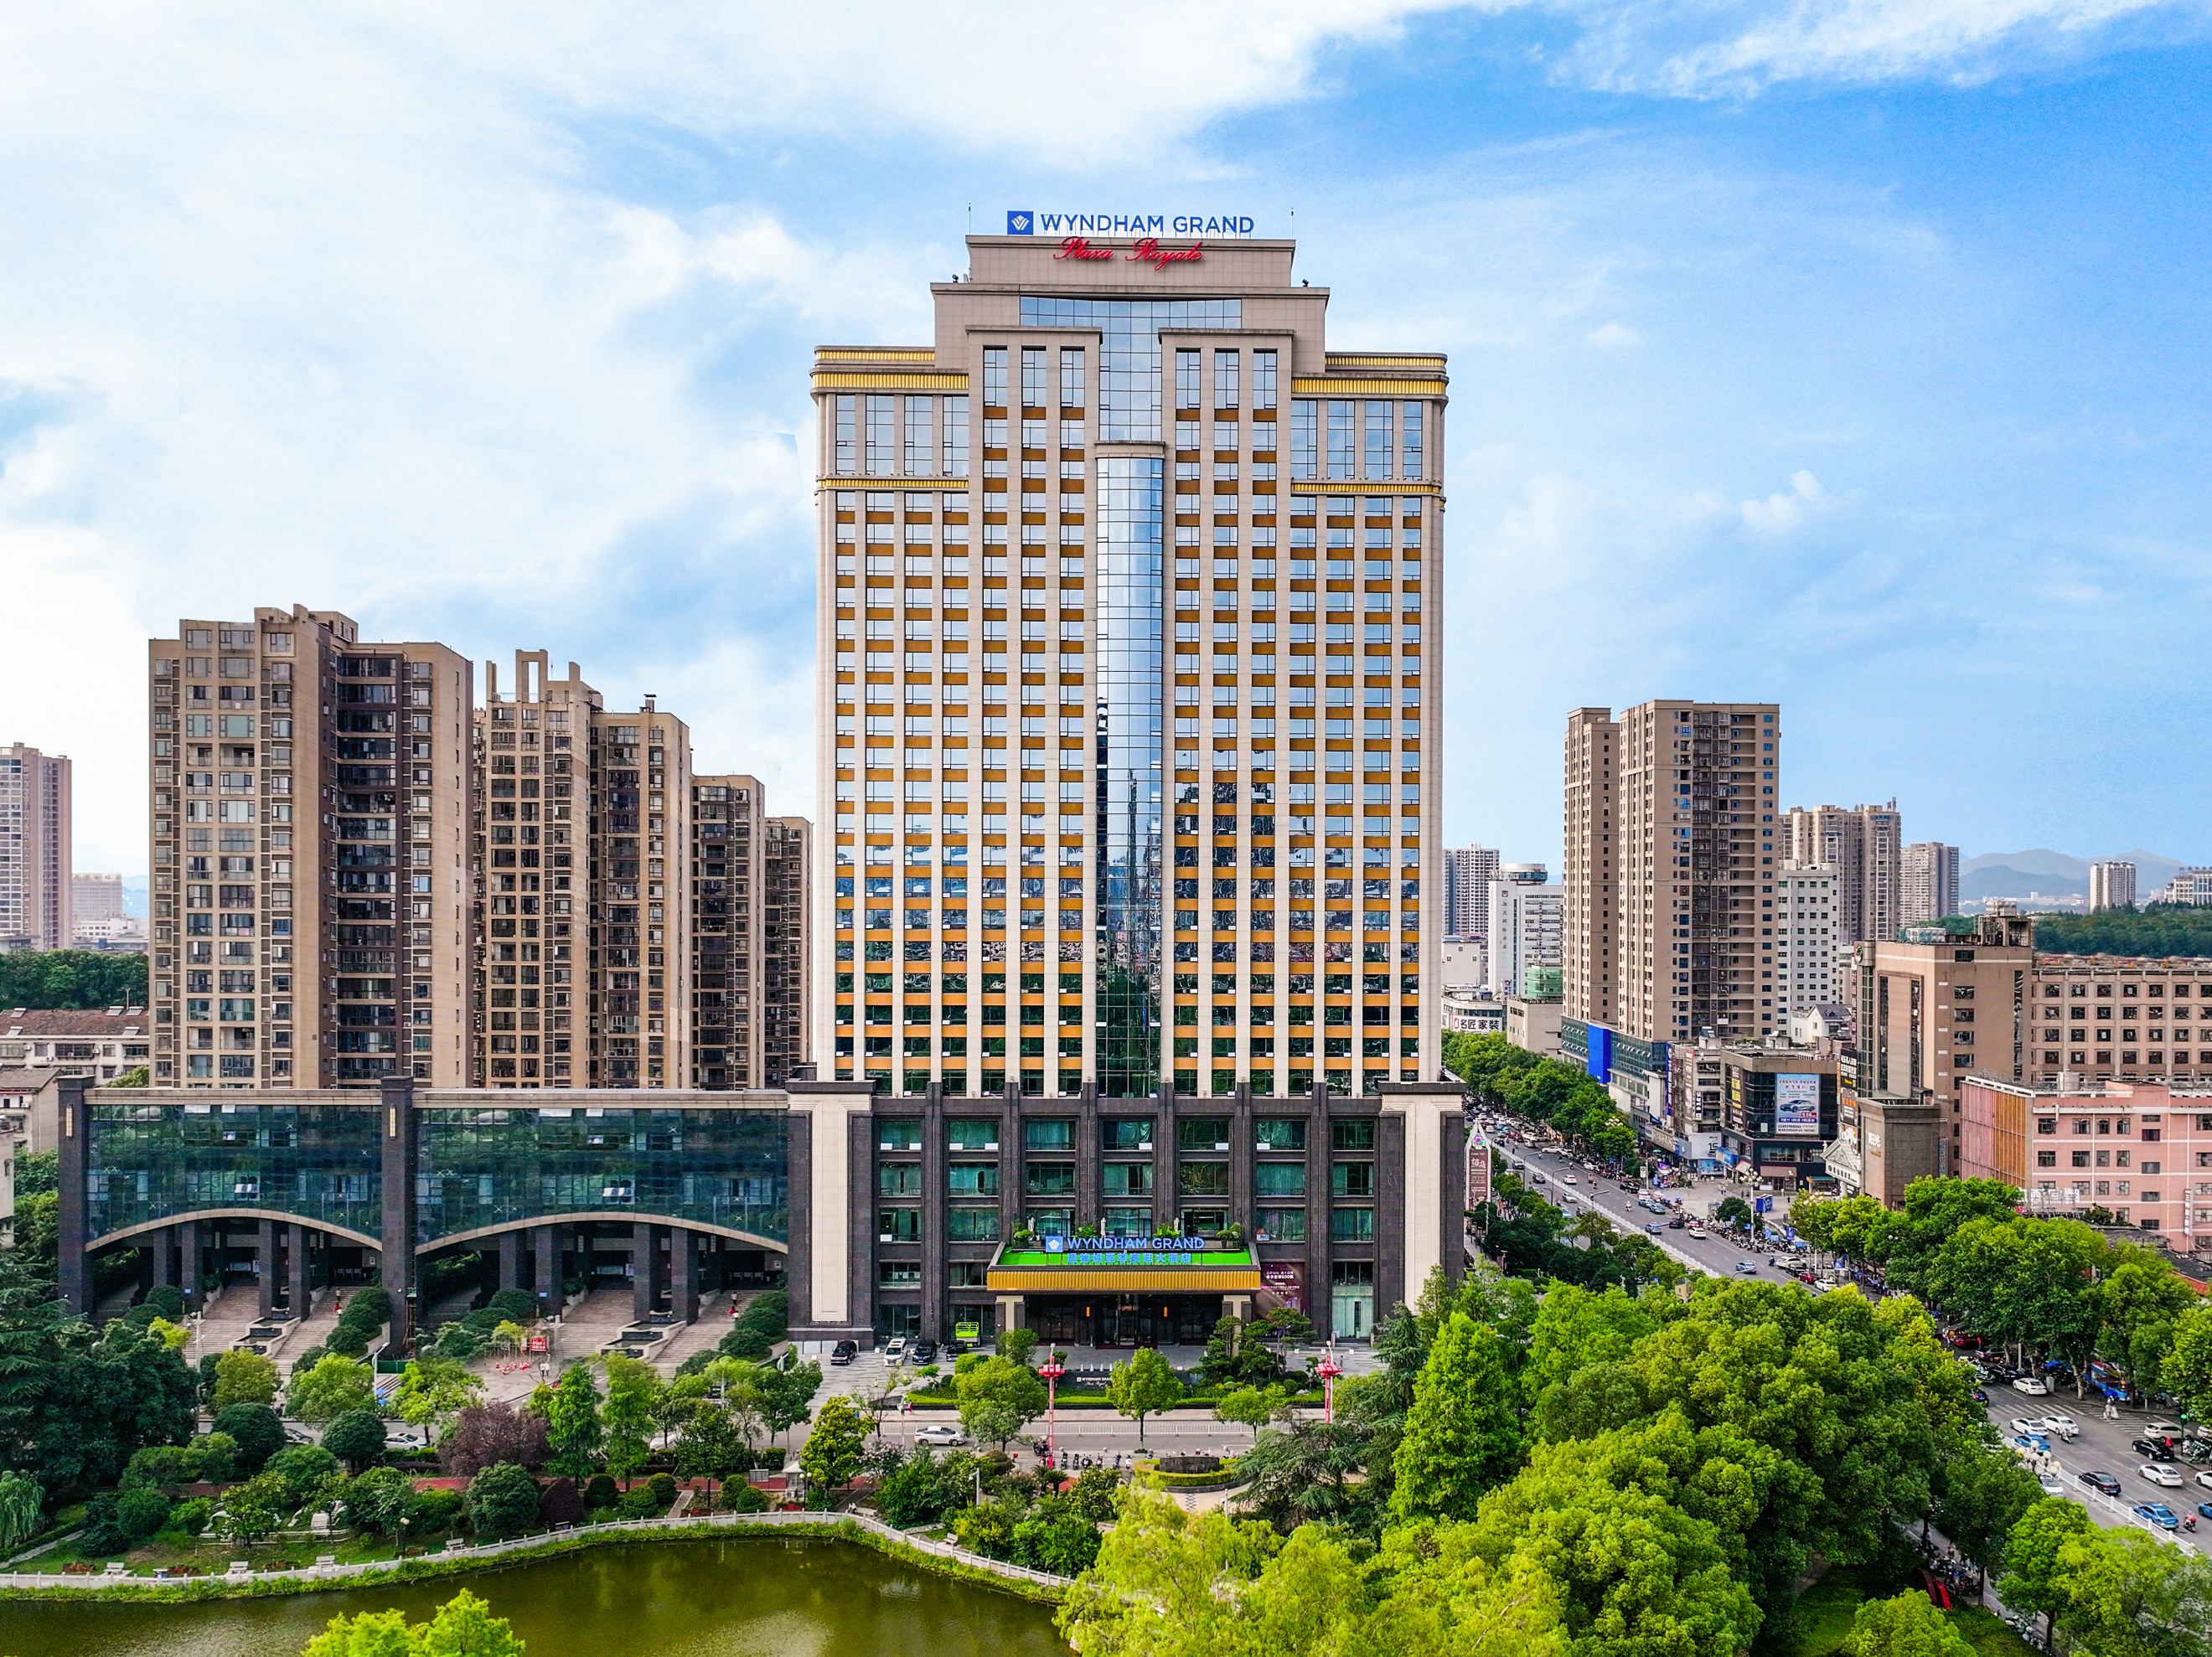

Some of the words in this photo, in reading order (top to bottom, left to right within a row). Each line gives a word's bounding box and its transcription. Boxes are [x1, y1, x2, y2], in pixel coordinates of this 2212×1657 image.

[1040, 214, 1164, 233] WYNDHAM
[1172, 215, 1254, 234] GRAND
[1053, 236, 1114, 260] Plaza
[1124, 237, 1203, 271] Royale
[1067, 1237, 1147, 1249] WYNDHAM
[1151, 1237, 1205, 1249] GRAND
